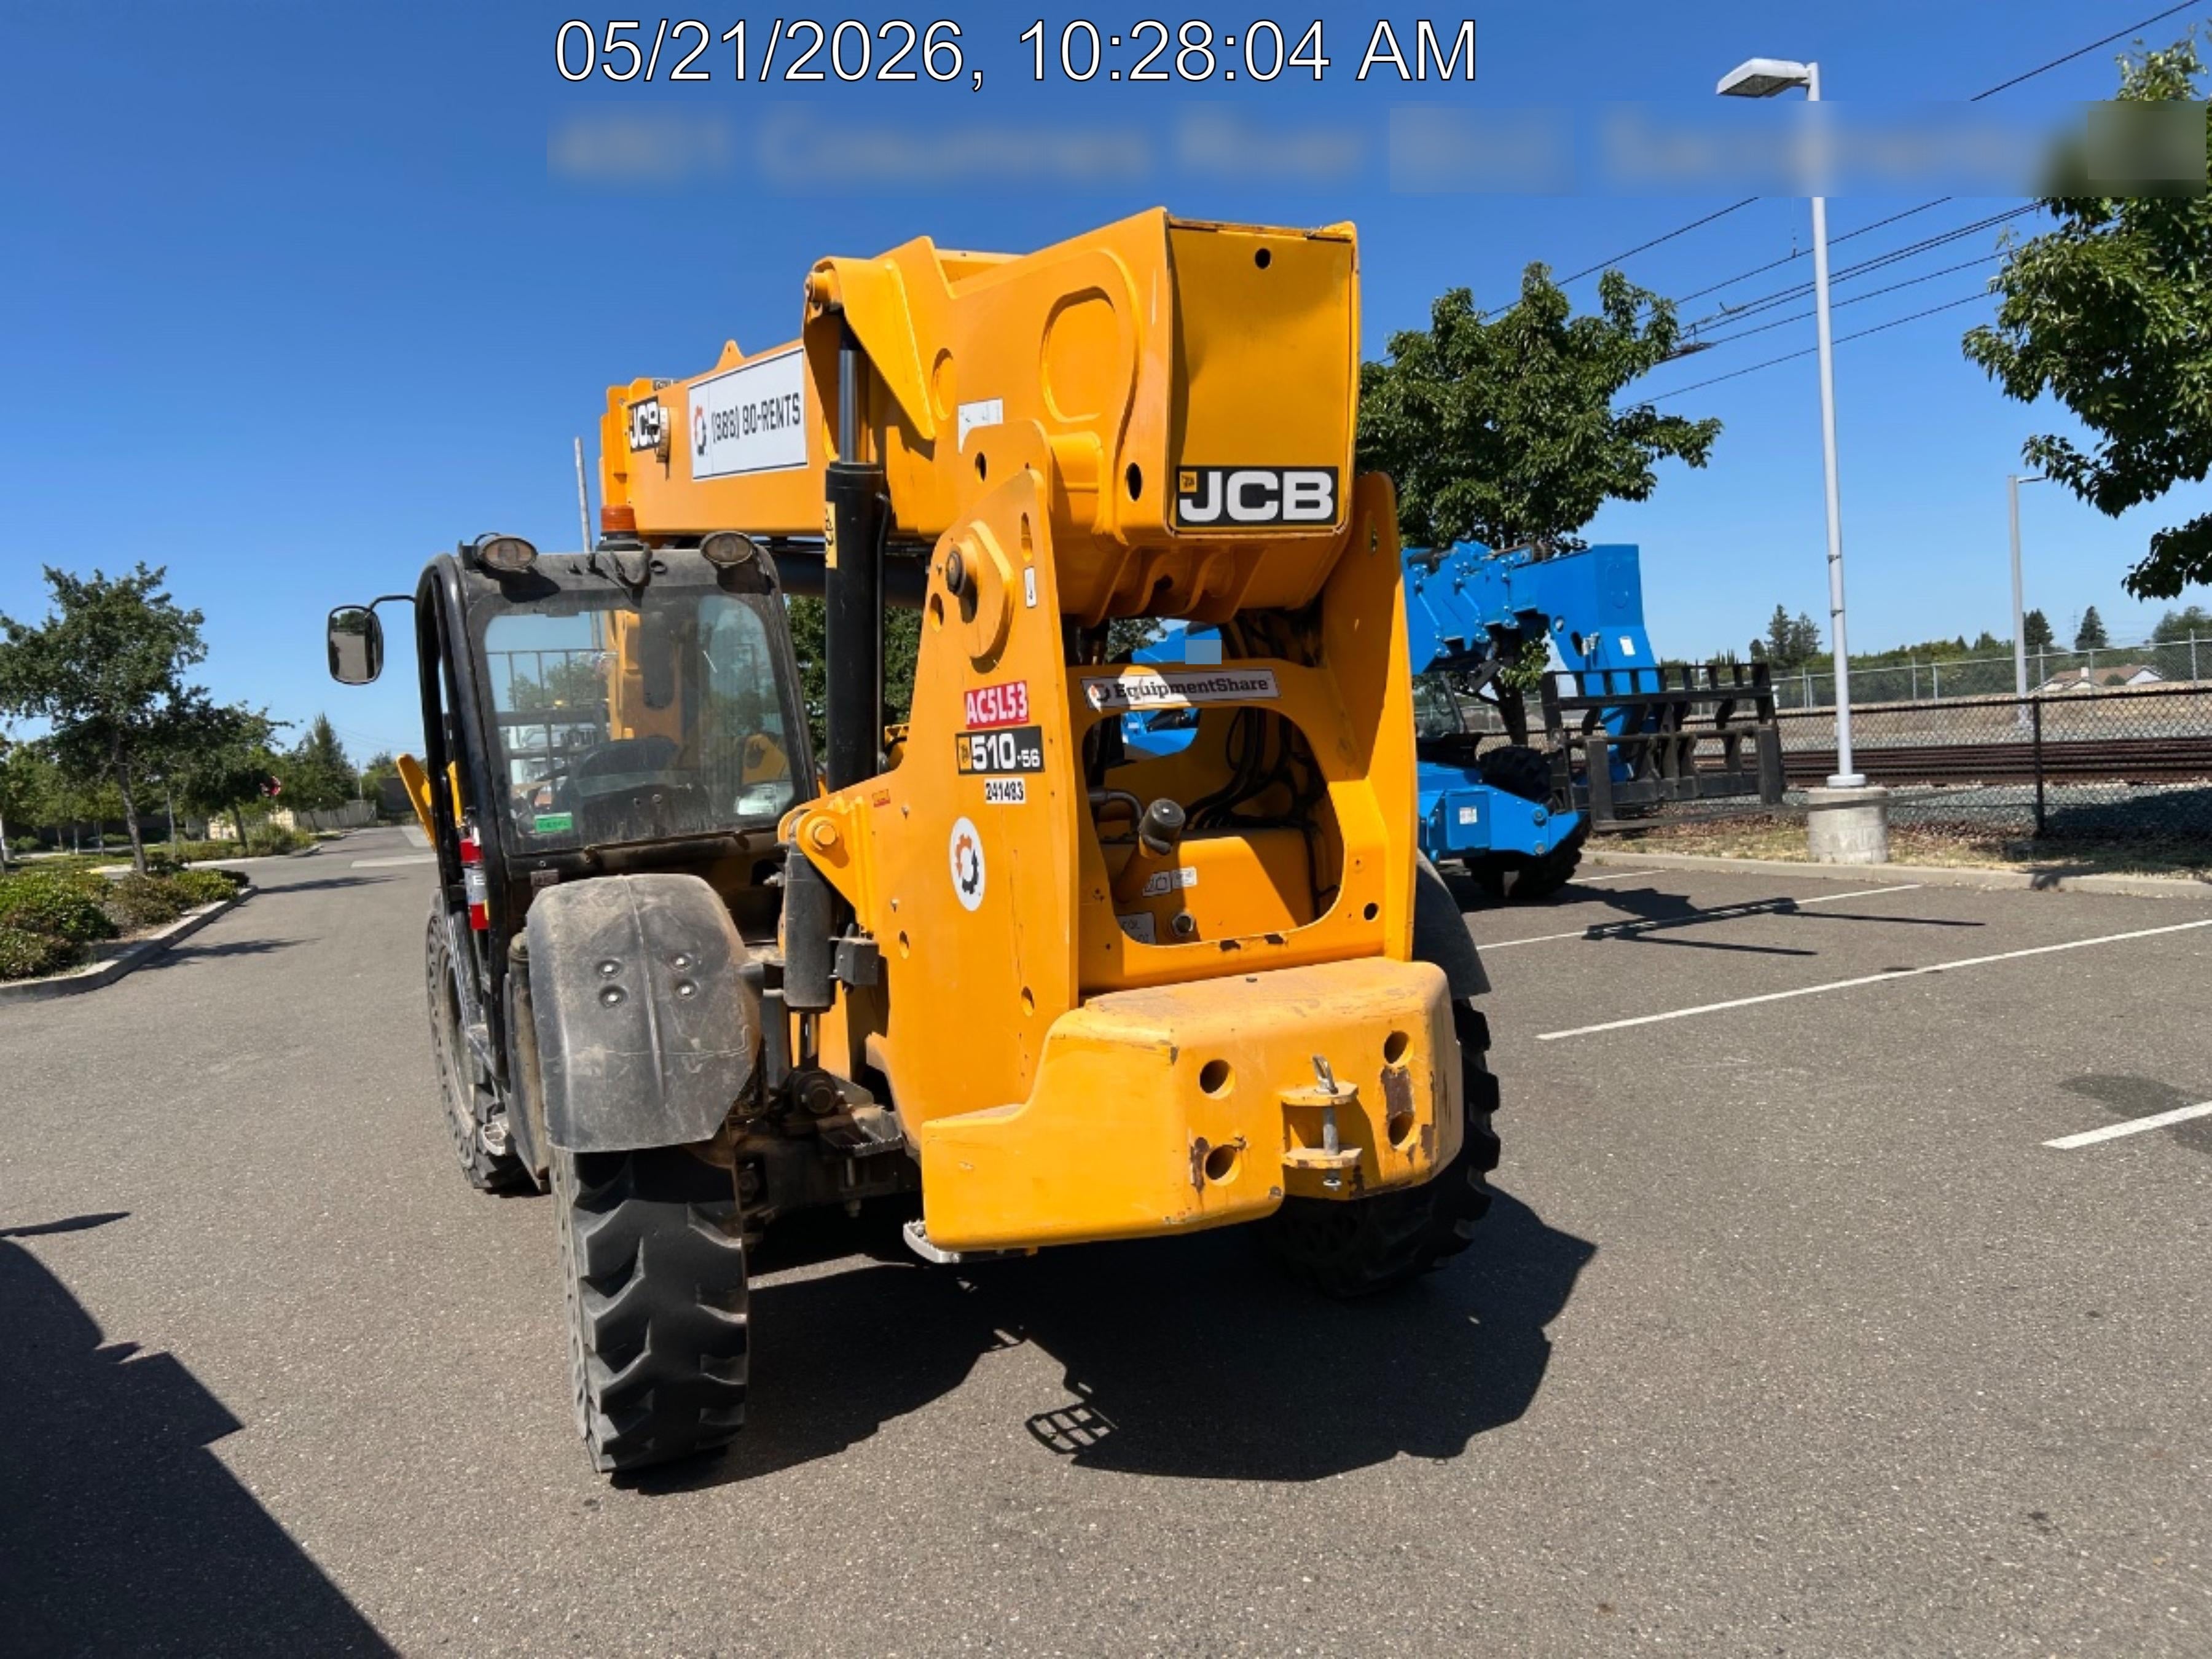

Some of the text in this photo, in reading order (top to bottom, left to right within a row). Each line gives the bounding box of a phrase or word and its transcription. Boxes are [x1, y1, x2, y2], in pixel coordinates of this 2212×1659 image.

[743, 392, 800, 436] 80-RENTS
[1179, 470, 1333, 522] JCB
[967, 682, 1028, 724] AC5L53
[1113, 677, 1269, 700] EquipmentShare
